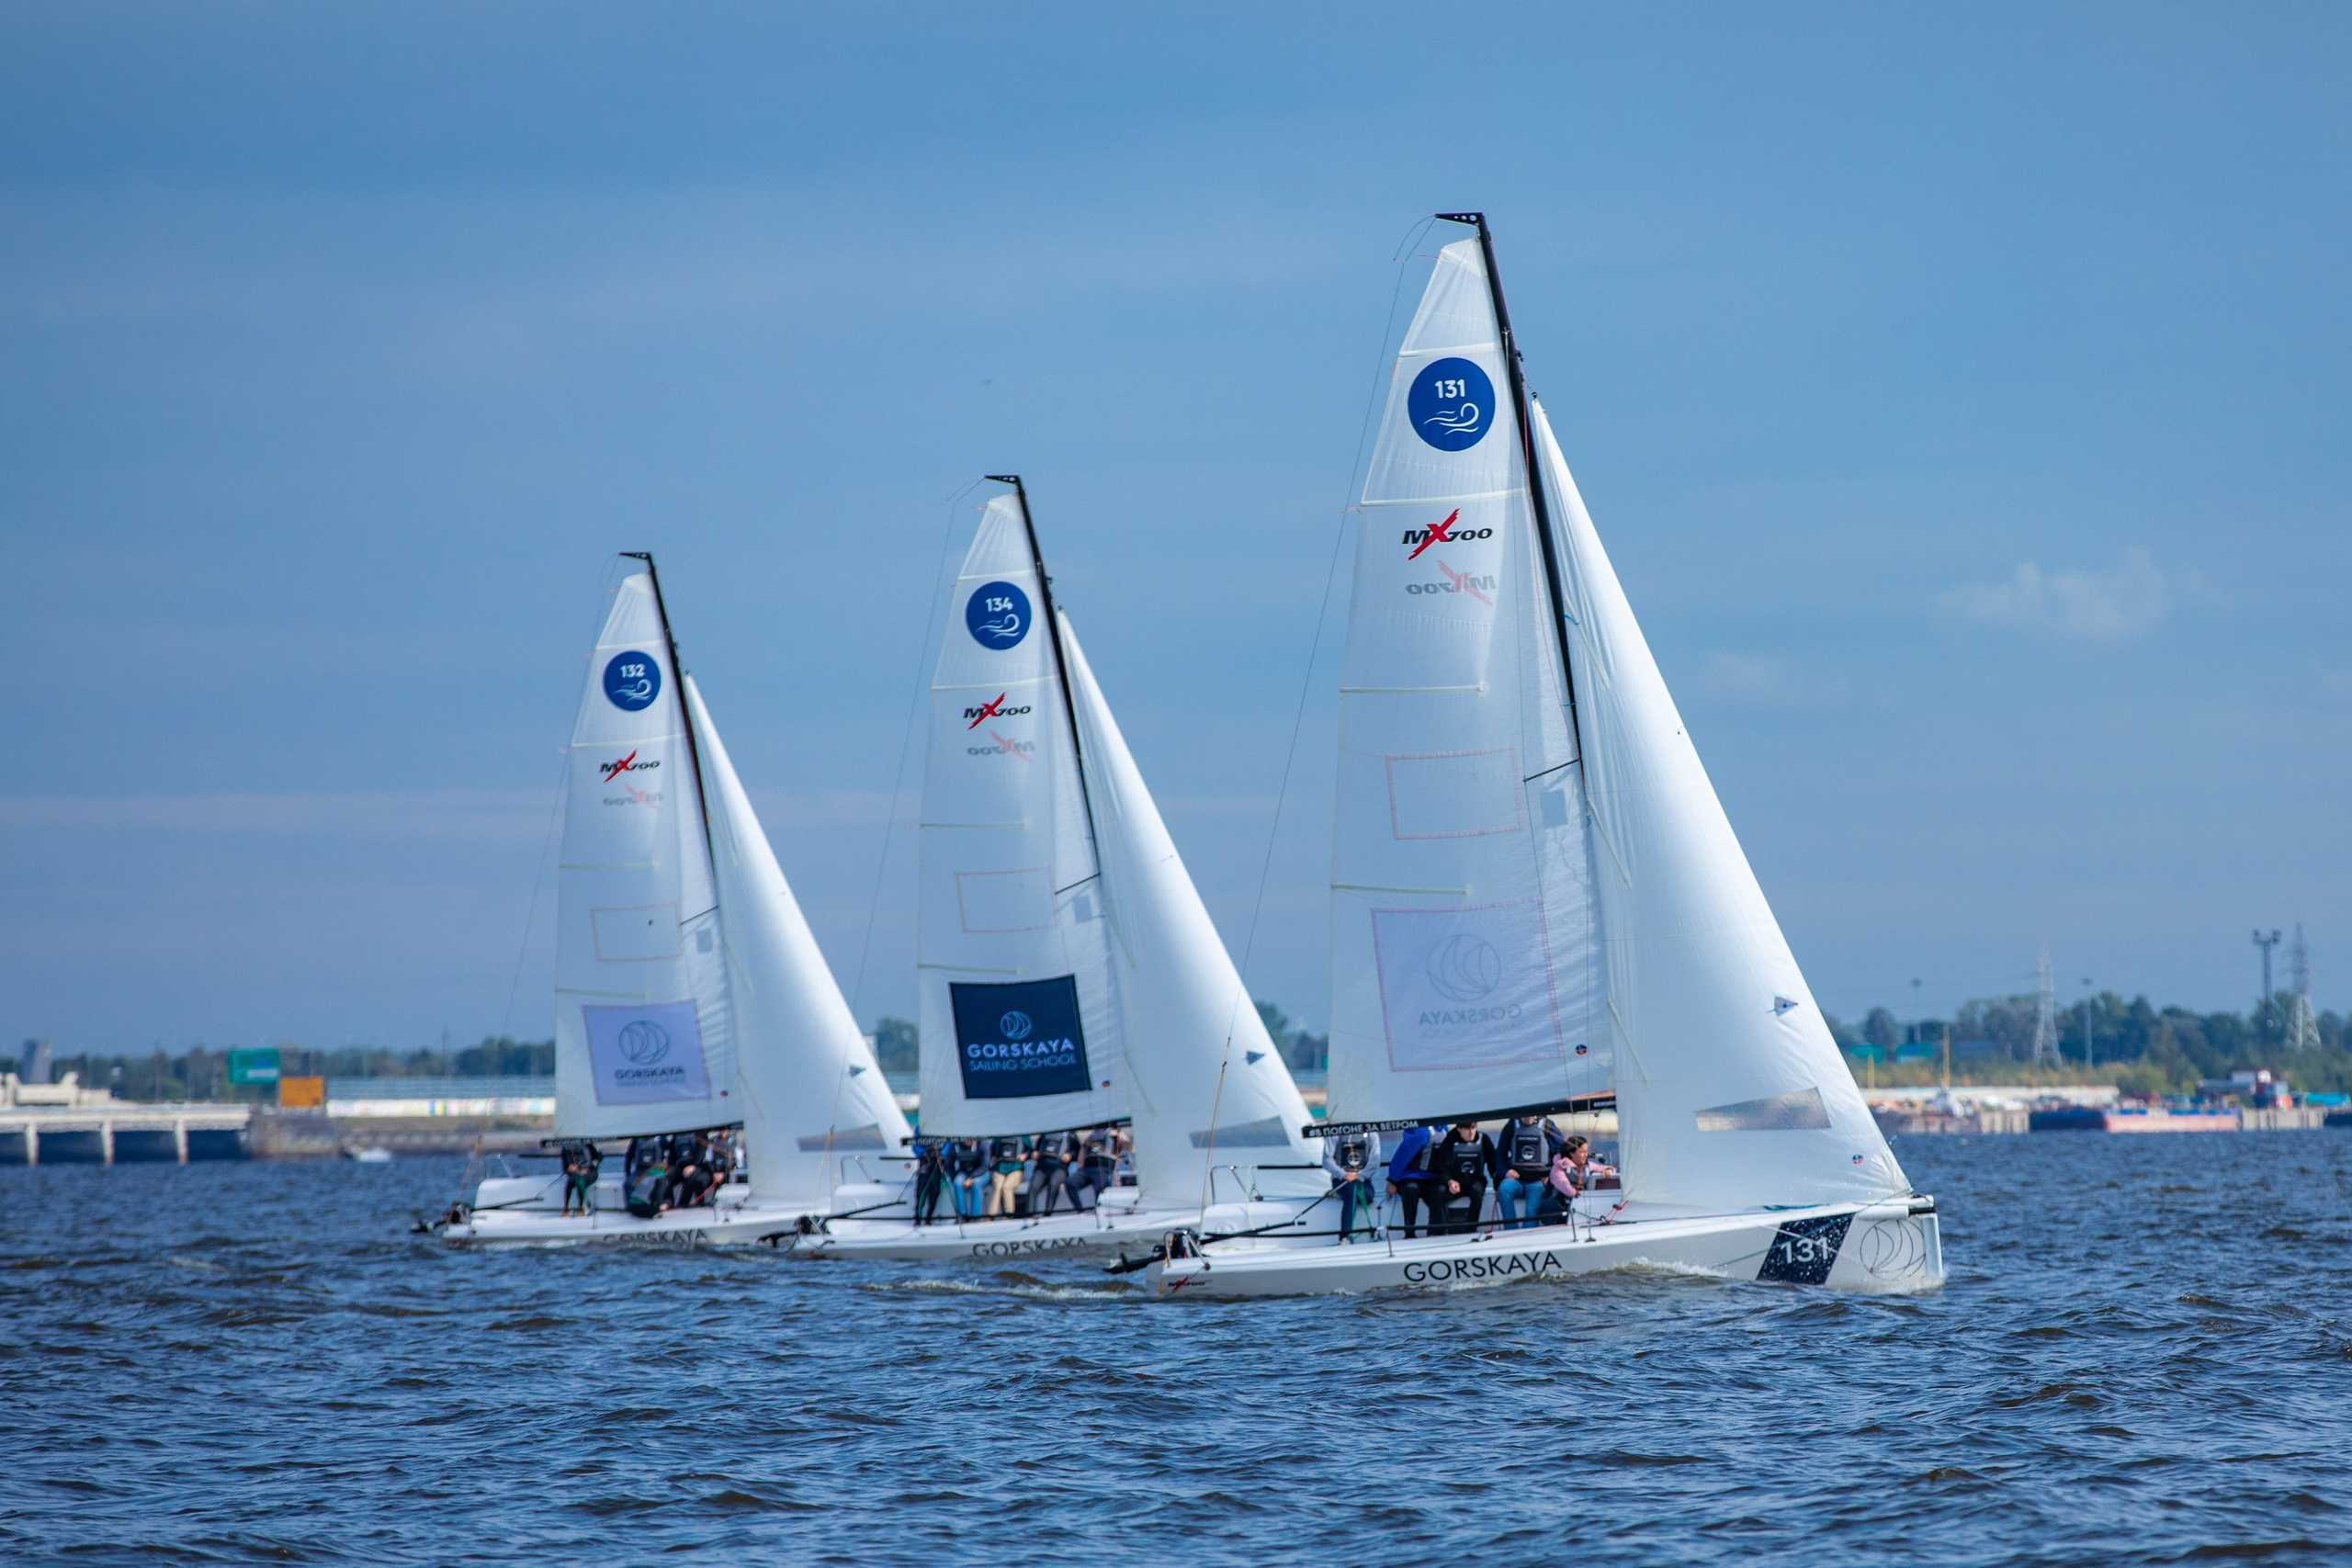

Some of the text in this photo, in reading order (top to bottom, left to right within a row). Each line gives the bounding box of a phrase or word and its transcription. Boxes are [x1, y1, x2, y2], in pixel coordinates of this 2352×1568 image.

[1434, 378, 1466, 399] 131
[1402, 508, 1493, 560] MX700
[985, 596, 1013, 612] 134
[620, 663, 646, 678] 132
[963, 691, 1032, 730] MX700
[967, 1037, 1075, 1058] GORSKAYA
[969, 1053, 1077, 1072] SAILING SCHOOL
[1323, 1124, 1363, 1136] ПОГОНЕ
[1365, 1122, 1379, 1132] ЗА
[1380, 1120, 1419, 1131] ВЕТРОМ
[1781, 1237, 1829, 1264] 131
[1404, 1250, 1563, 1282] GORSKAYA
